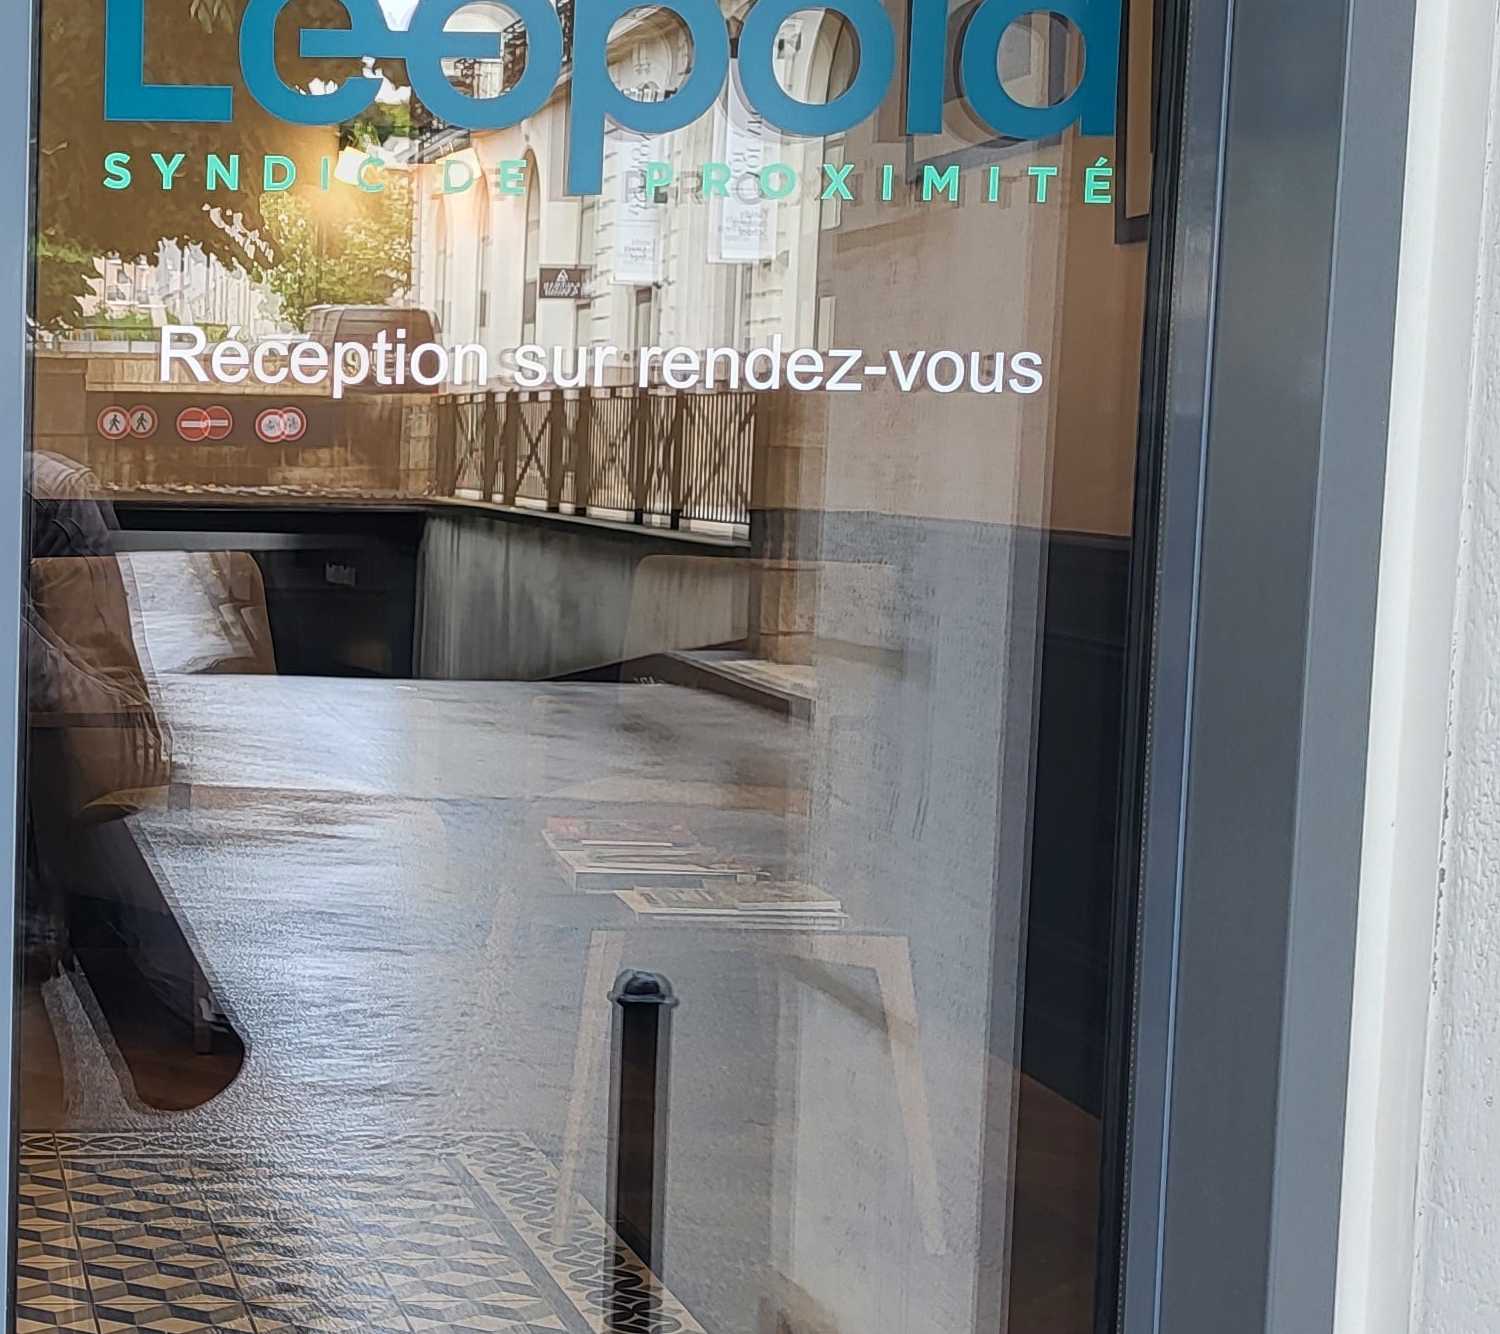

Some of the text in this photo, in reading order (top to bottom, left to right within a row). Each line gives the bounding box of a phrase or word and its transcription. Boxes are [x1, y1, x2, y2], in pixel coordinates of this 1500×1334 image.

[102, 152, 386, 193] SYNDIC
[443, 158, 527, 196] DE
[645, 156, 1114, 204] PROXIMITÉ
[158, 323, 1043, 400] Réception sur rendez-vous
